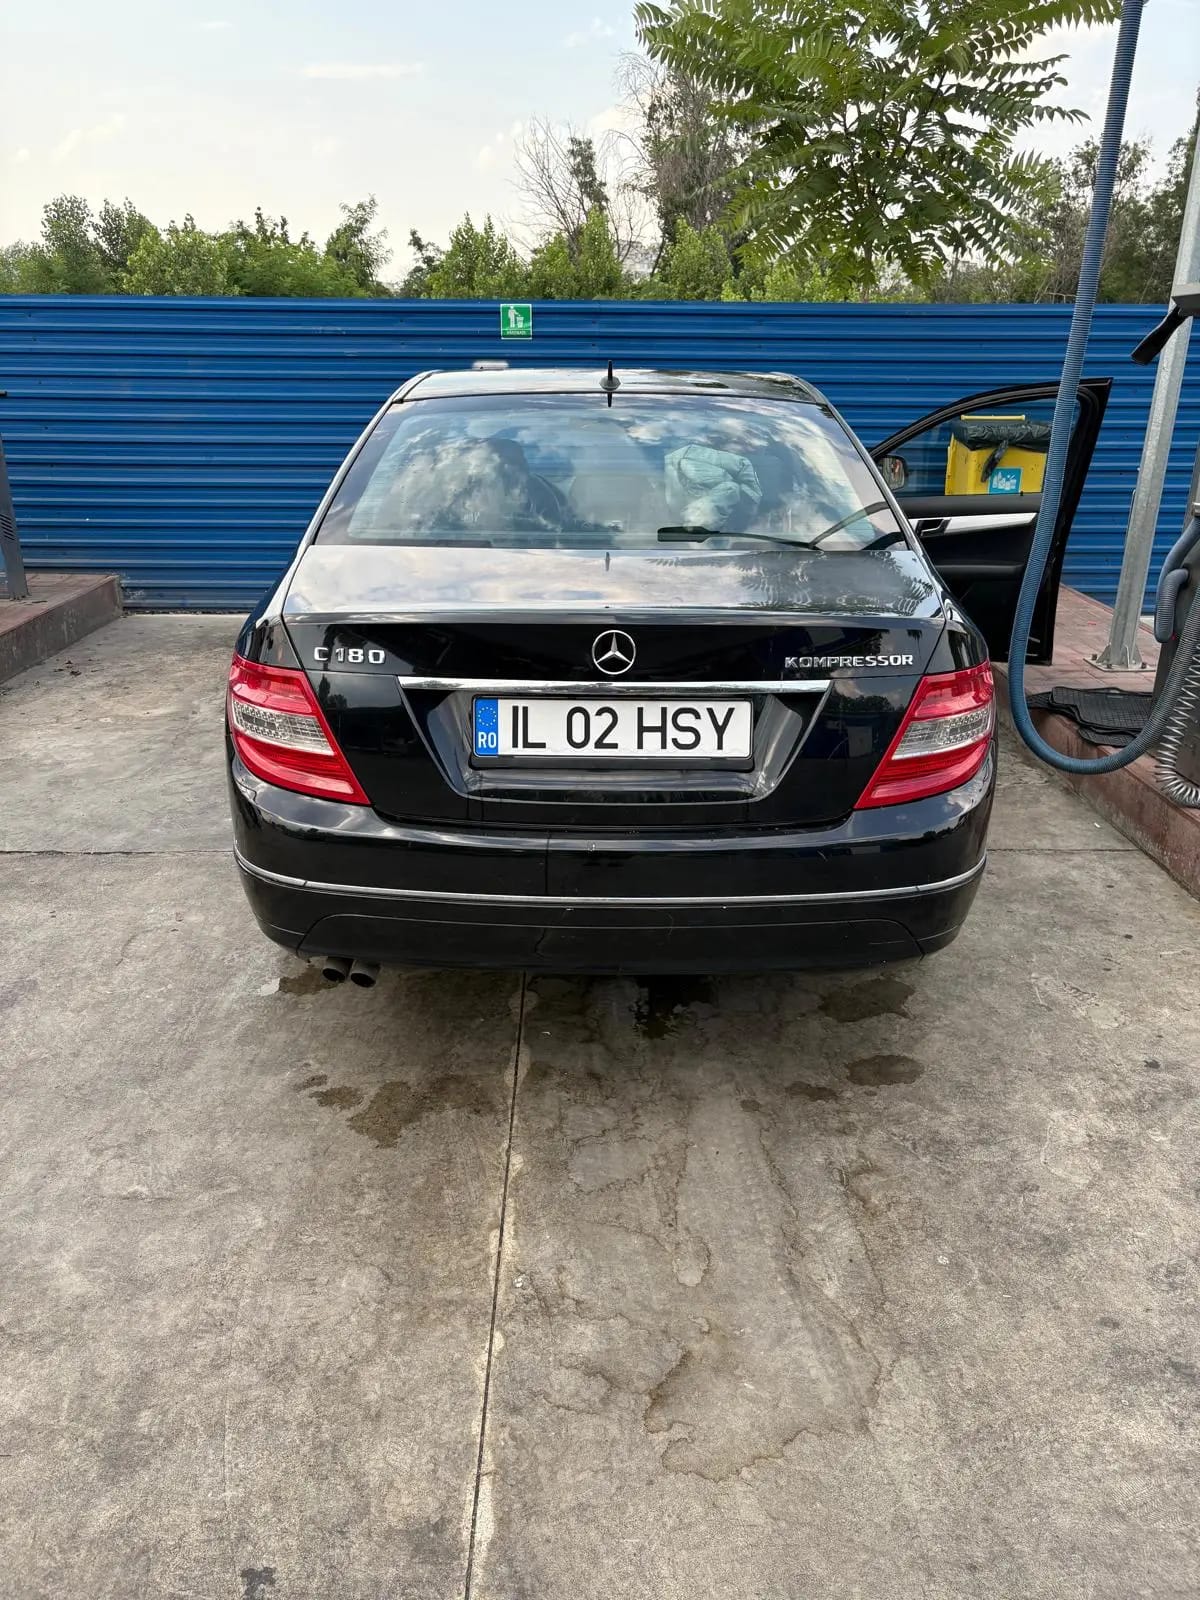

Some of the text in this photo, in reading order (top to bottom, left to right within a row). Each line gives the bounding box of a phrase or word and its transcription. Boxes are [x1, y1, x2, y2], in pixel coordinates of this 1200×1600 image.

[313, 646, 386, 664] C 180
[784, 654, 913, 668] KOMPRESSOR
[511, 705, 735, 751] IL 02 HSY
[478, 731, 497, 748] RO
